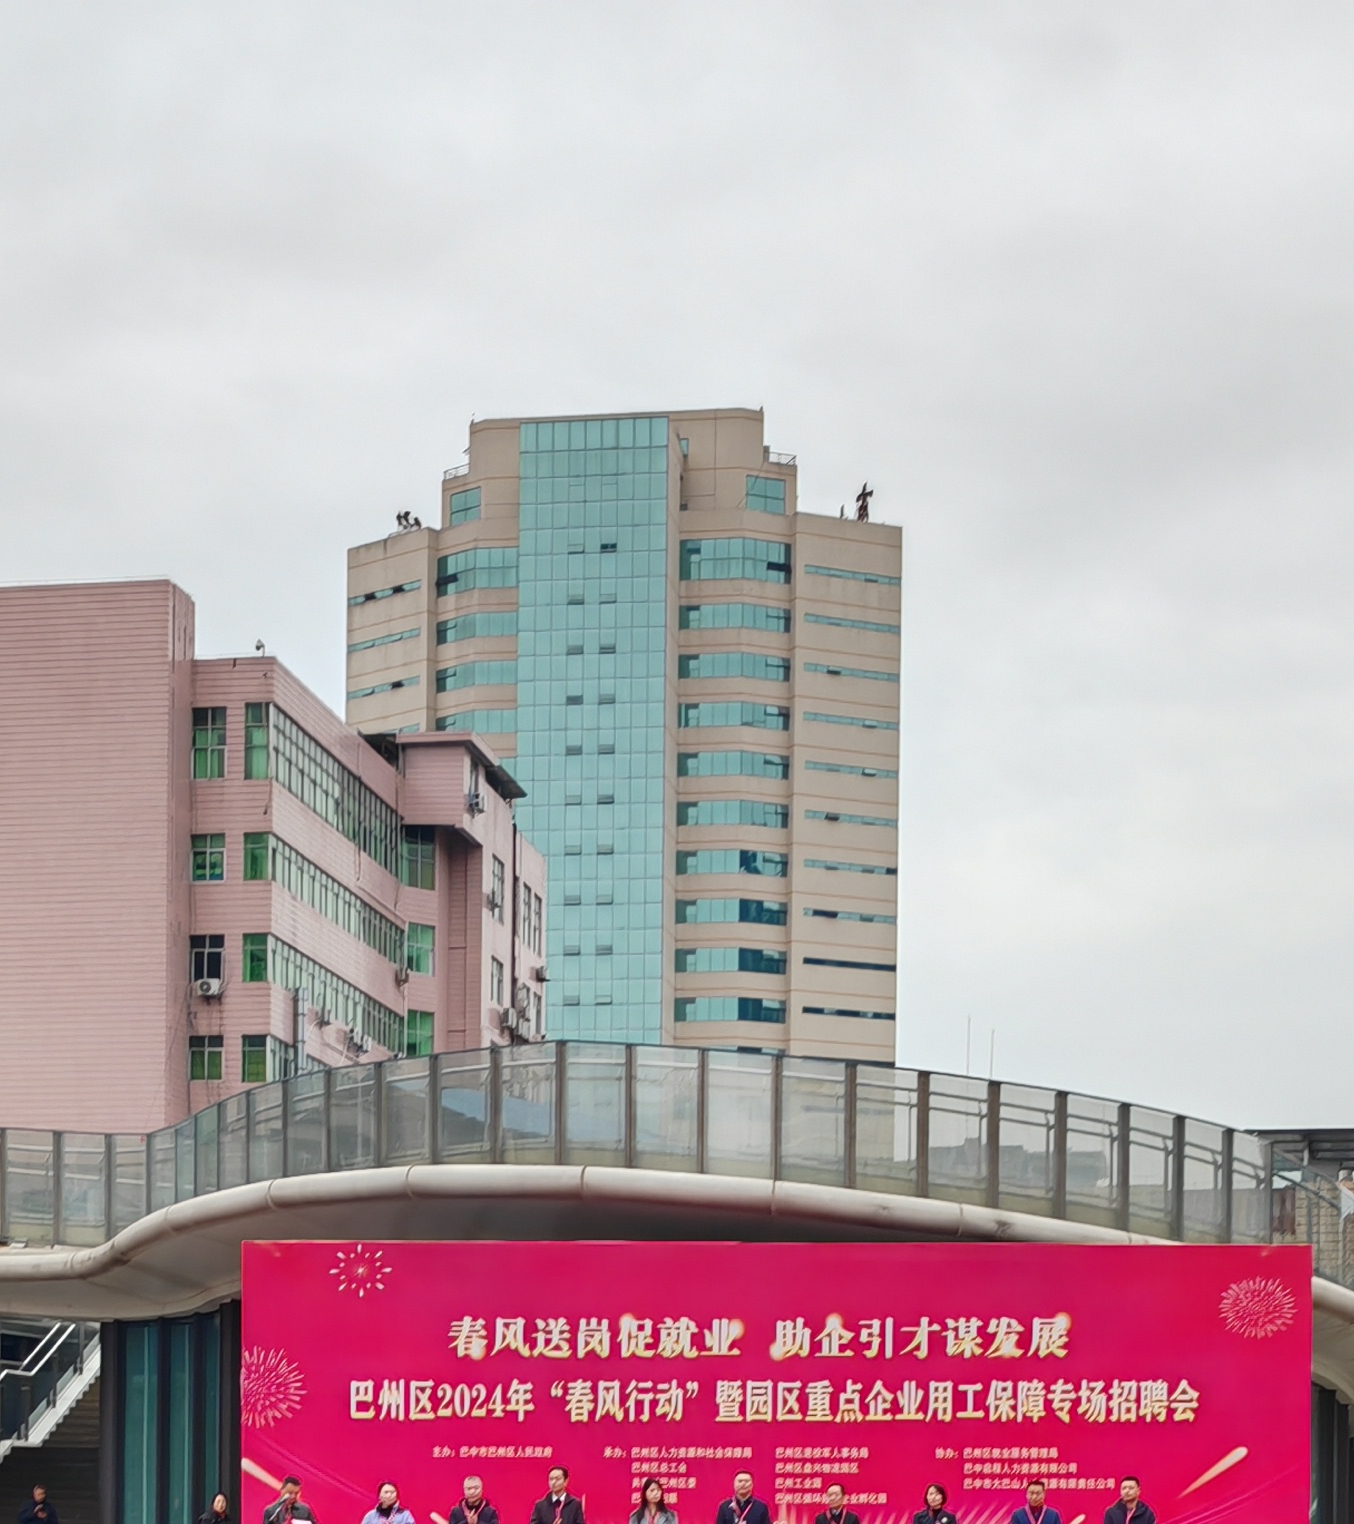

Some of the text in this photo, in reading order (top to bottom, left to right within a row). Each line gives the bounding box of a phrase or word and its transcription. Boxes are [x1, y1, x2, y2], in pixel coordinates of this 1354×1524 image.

[448, 1313, 1071, 1361] 春风送岗促就业 助企引才谋发展
[348, 1377, 1201, 1424] 巴州区2024年“春风行动”暨园区重点企业用工保障专场招聘会
